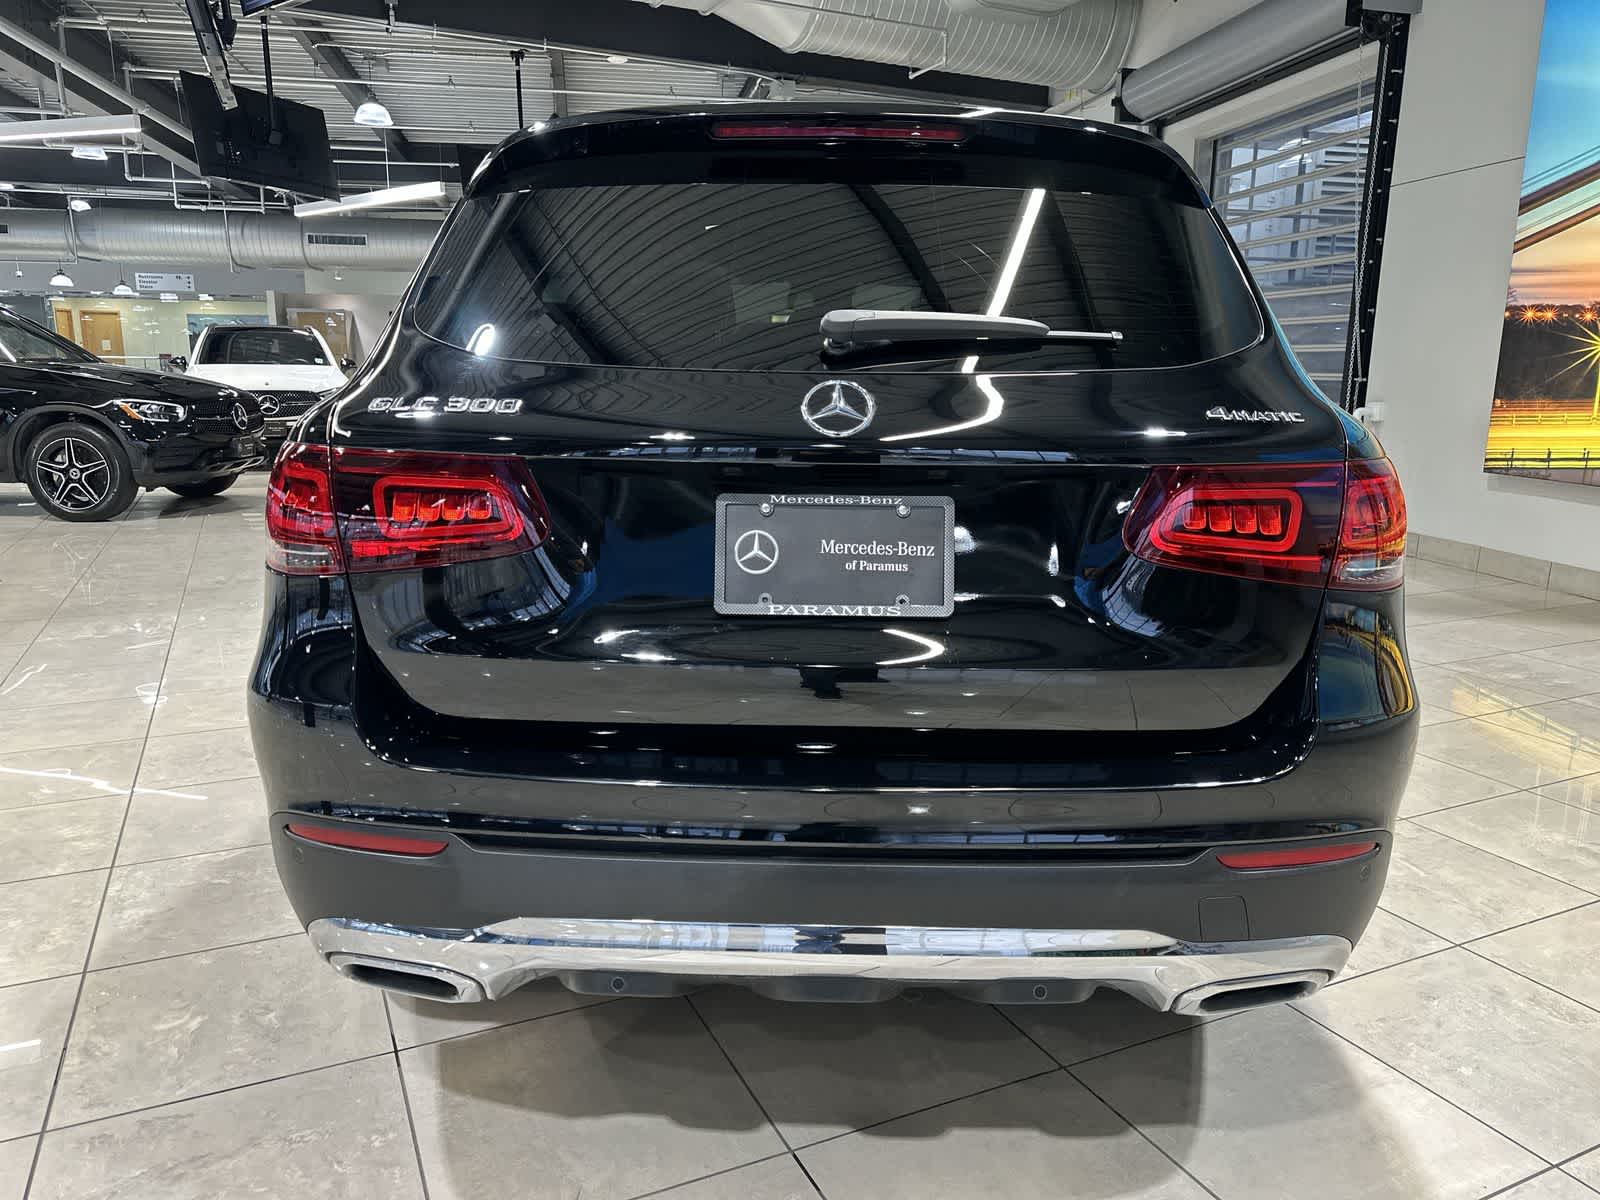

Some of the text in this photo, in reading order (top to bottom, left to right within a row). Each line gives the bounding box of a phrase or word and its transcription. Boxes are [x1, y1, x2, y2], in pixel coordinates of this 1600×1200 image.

[368, 396, 522, 413] GLC 300
[1205, 406, 1305, 423] 4MATIC
[769, 495, 903, 505] Mercedes-Benz
[820, 539, 935, 557] Mercedes-Benz
[845, 560, 909, 572] of Paramus
[767, 605, 902, 616] PARAMUS
